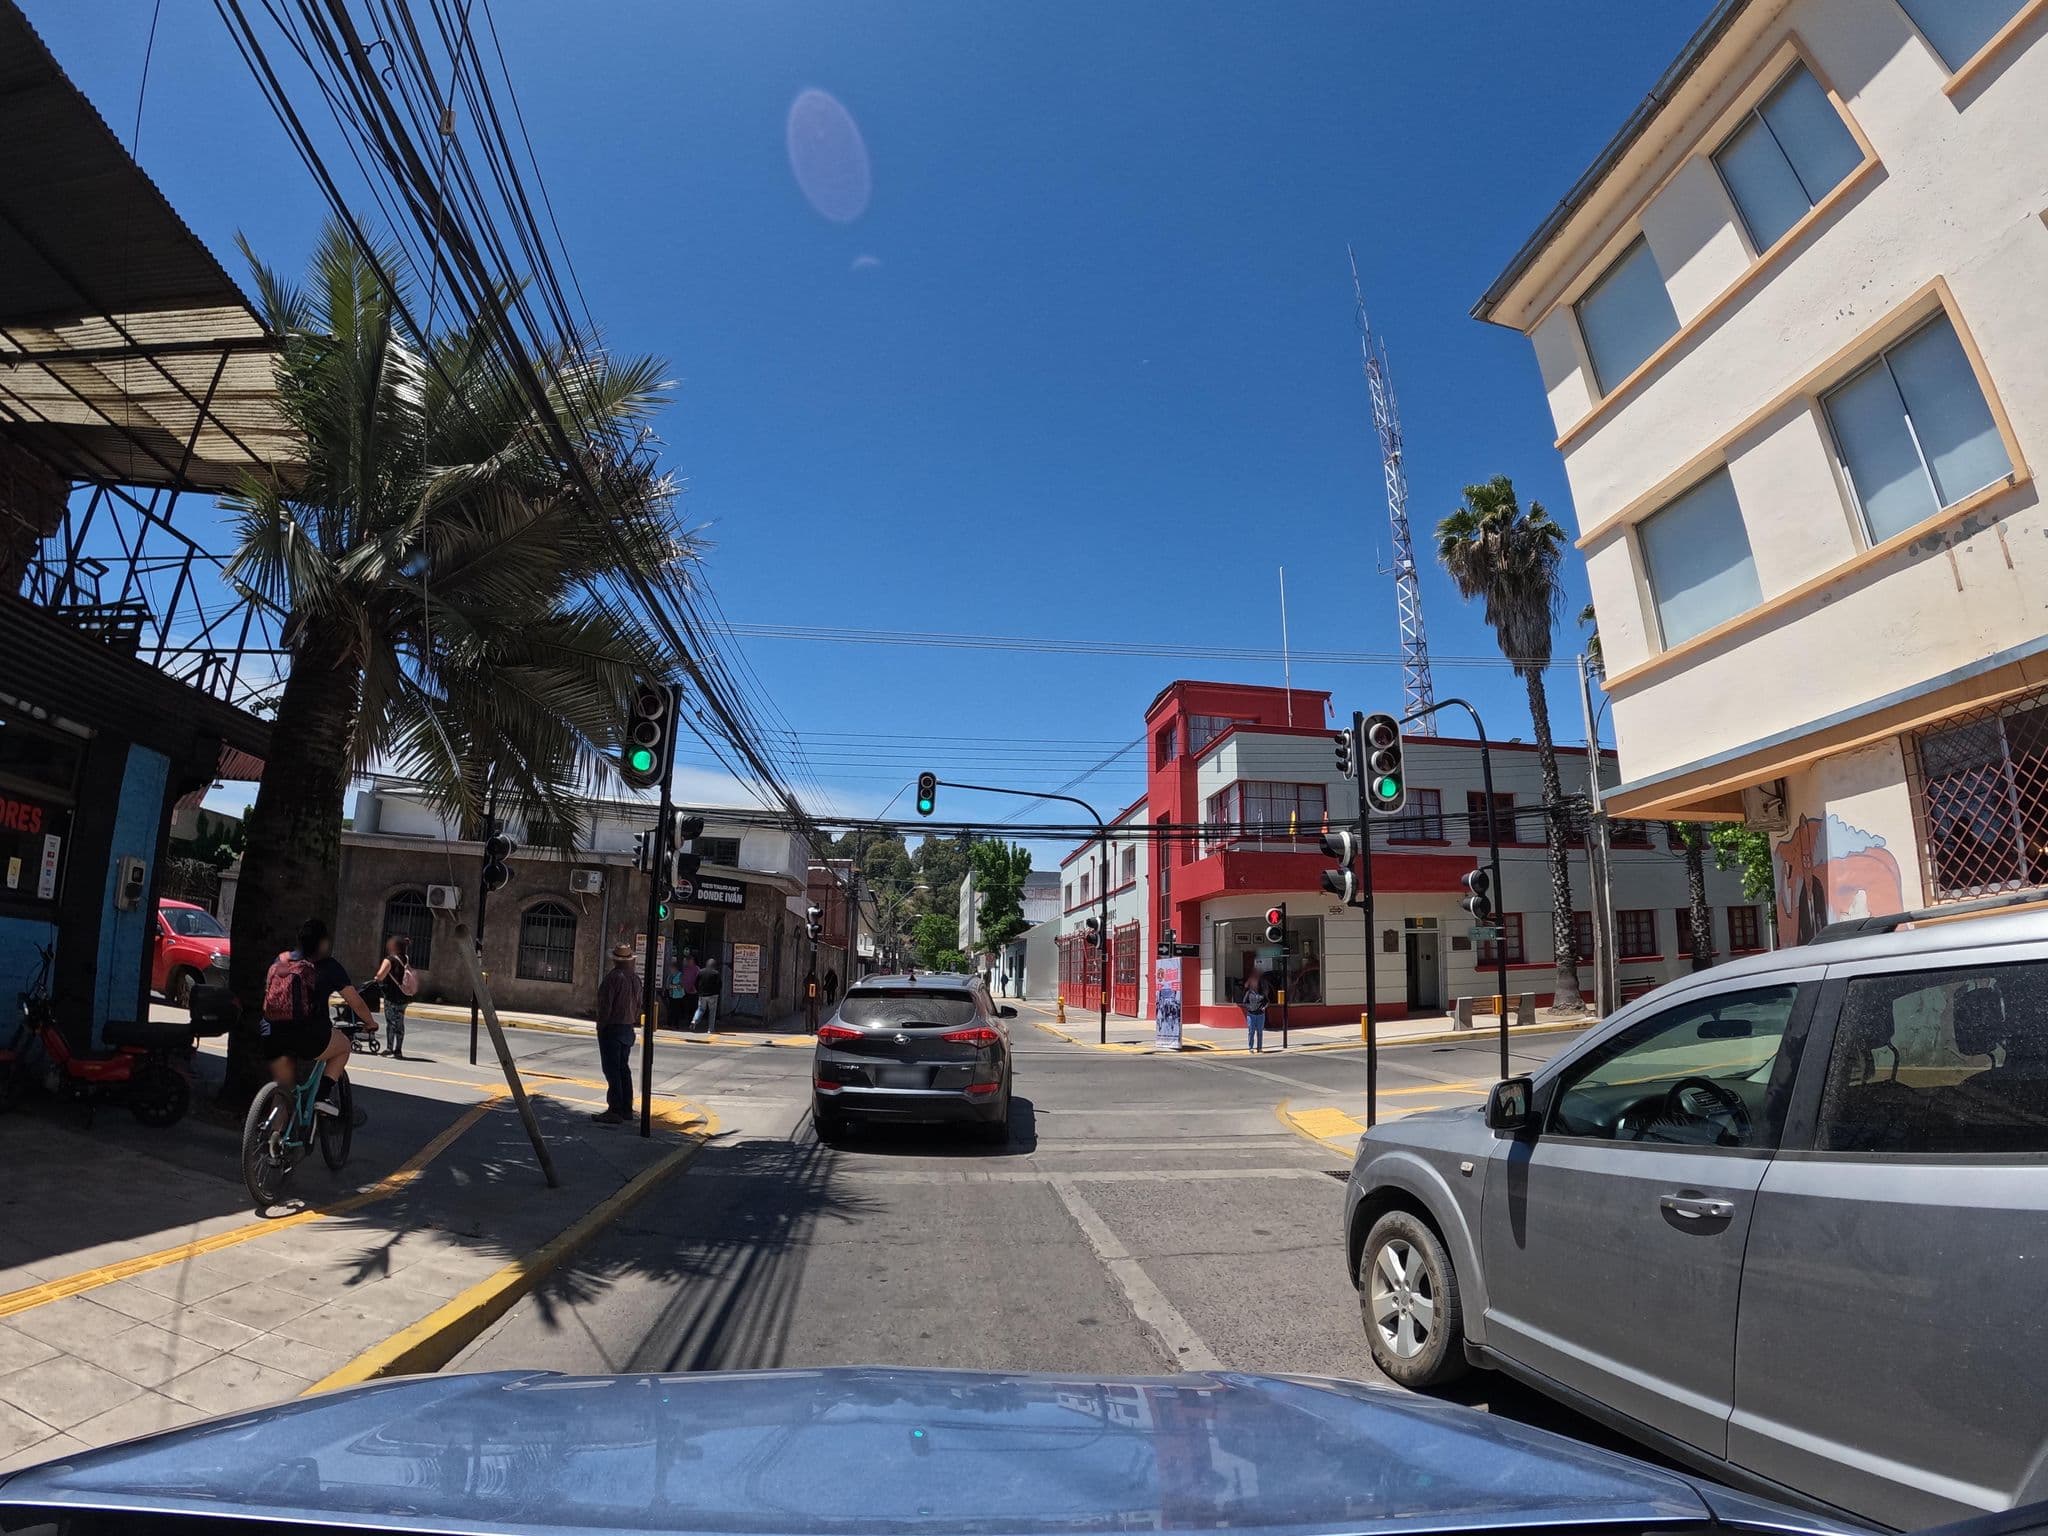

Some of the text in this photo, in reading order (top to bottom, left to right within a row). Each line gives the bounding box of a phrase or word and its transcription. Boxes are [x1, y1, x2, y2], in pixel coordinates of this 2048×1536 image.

[702, 883, 740, 892] RESTAURANT
[697, 890, 743, 904] DONDE IVÁN
